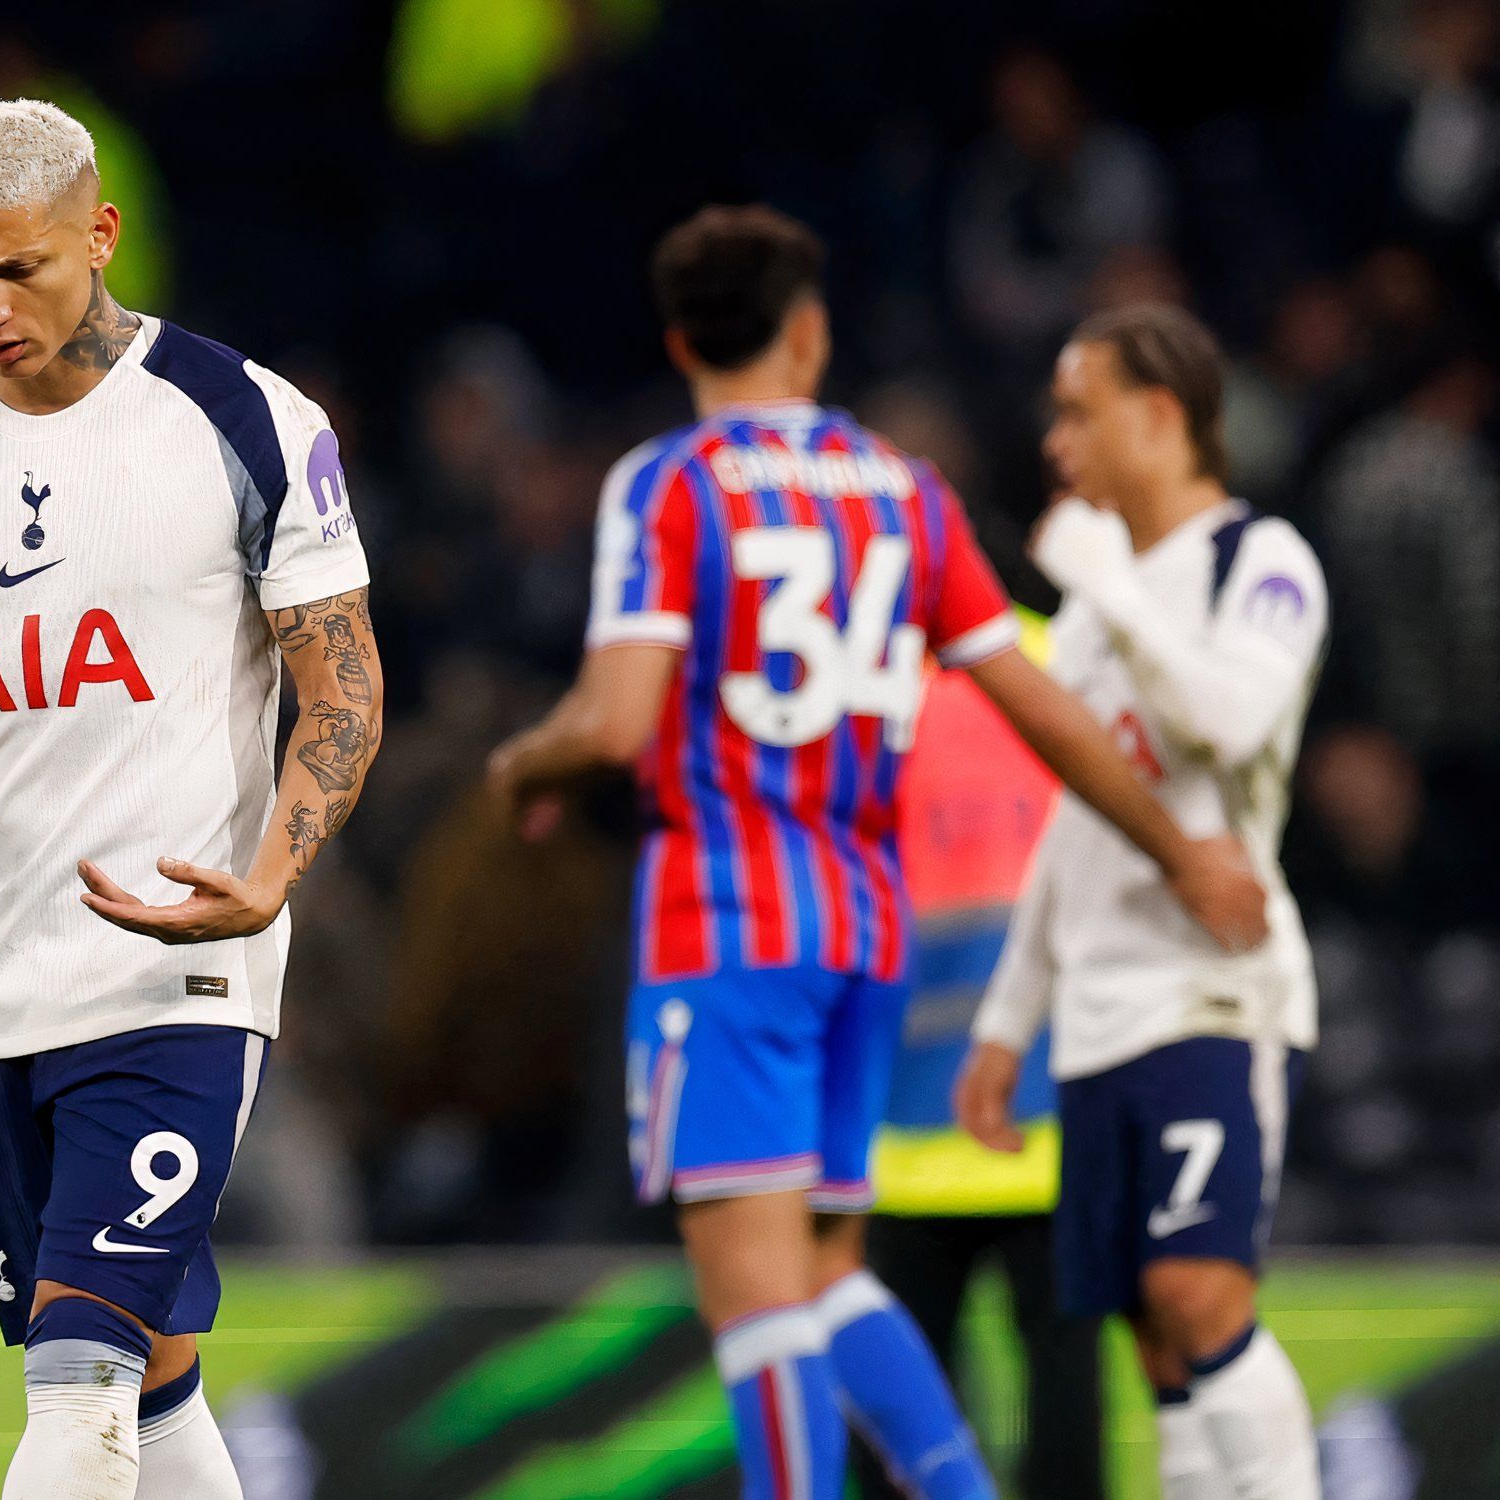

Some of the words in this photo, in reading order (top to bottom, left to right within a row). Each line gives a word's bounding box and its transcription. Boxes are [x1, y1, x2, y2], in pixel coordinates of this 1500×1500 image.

[718, 525, 926, 753] 34
[123, 1131, 199, 1230] 9
[1161, 1118, 1225, 1212] 7
